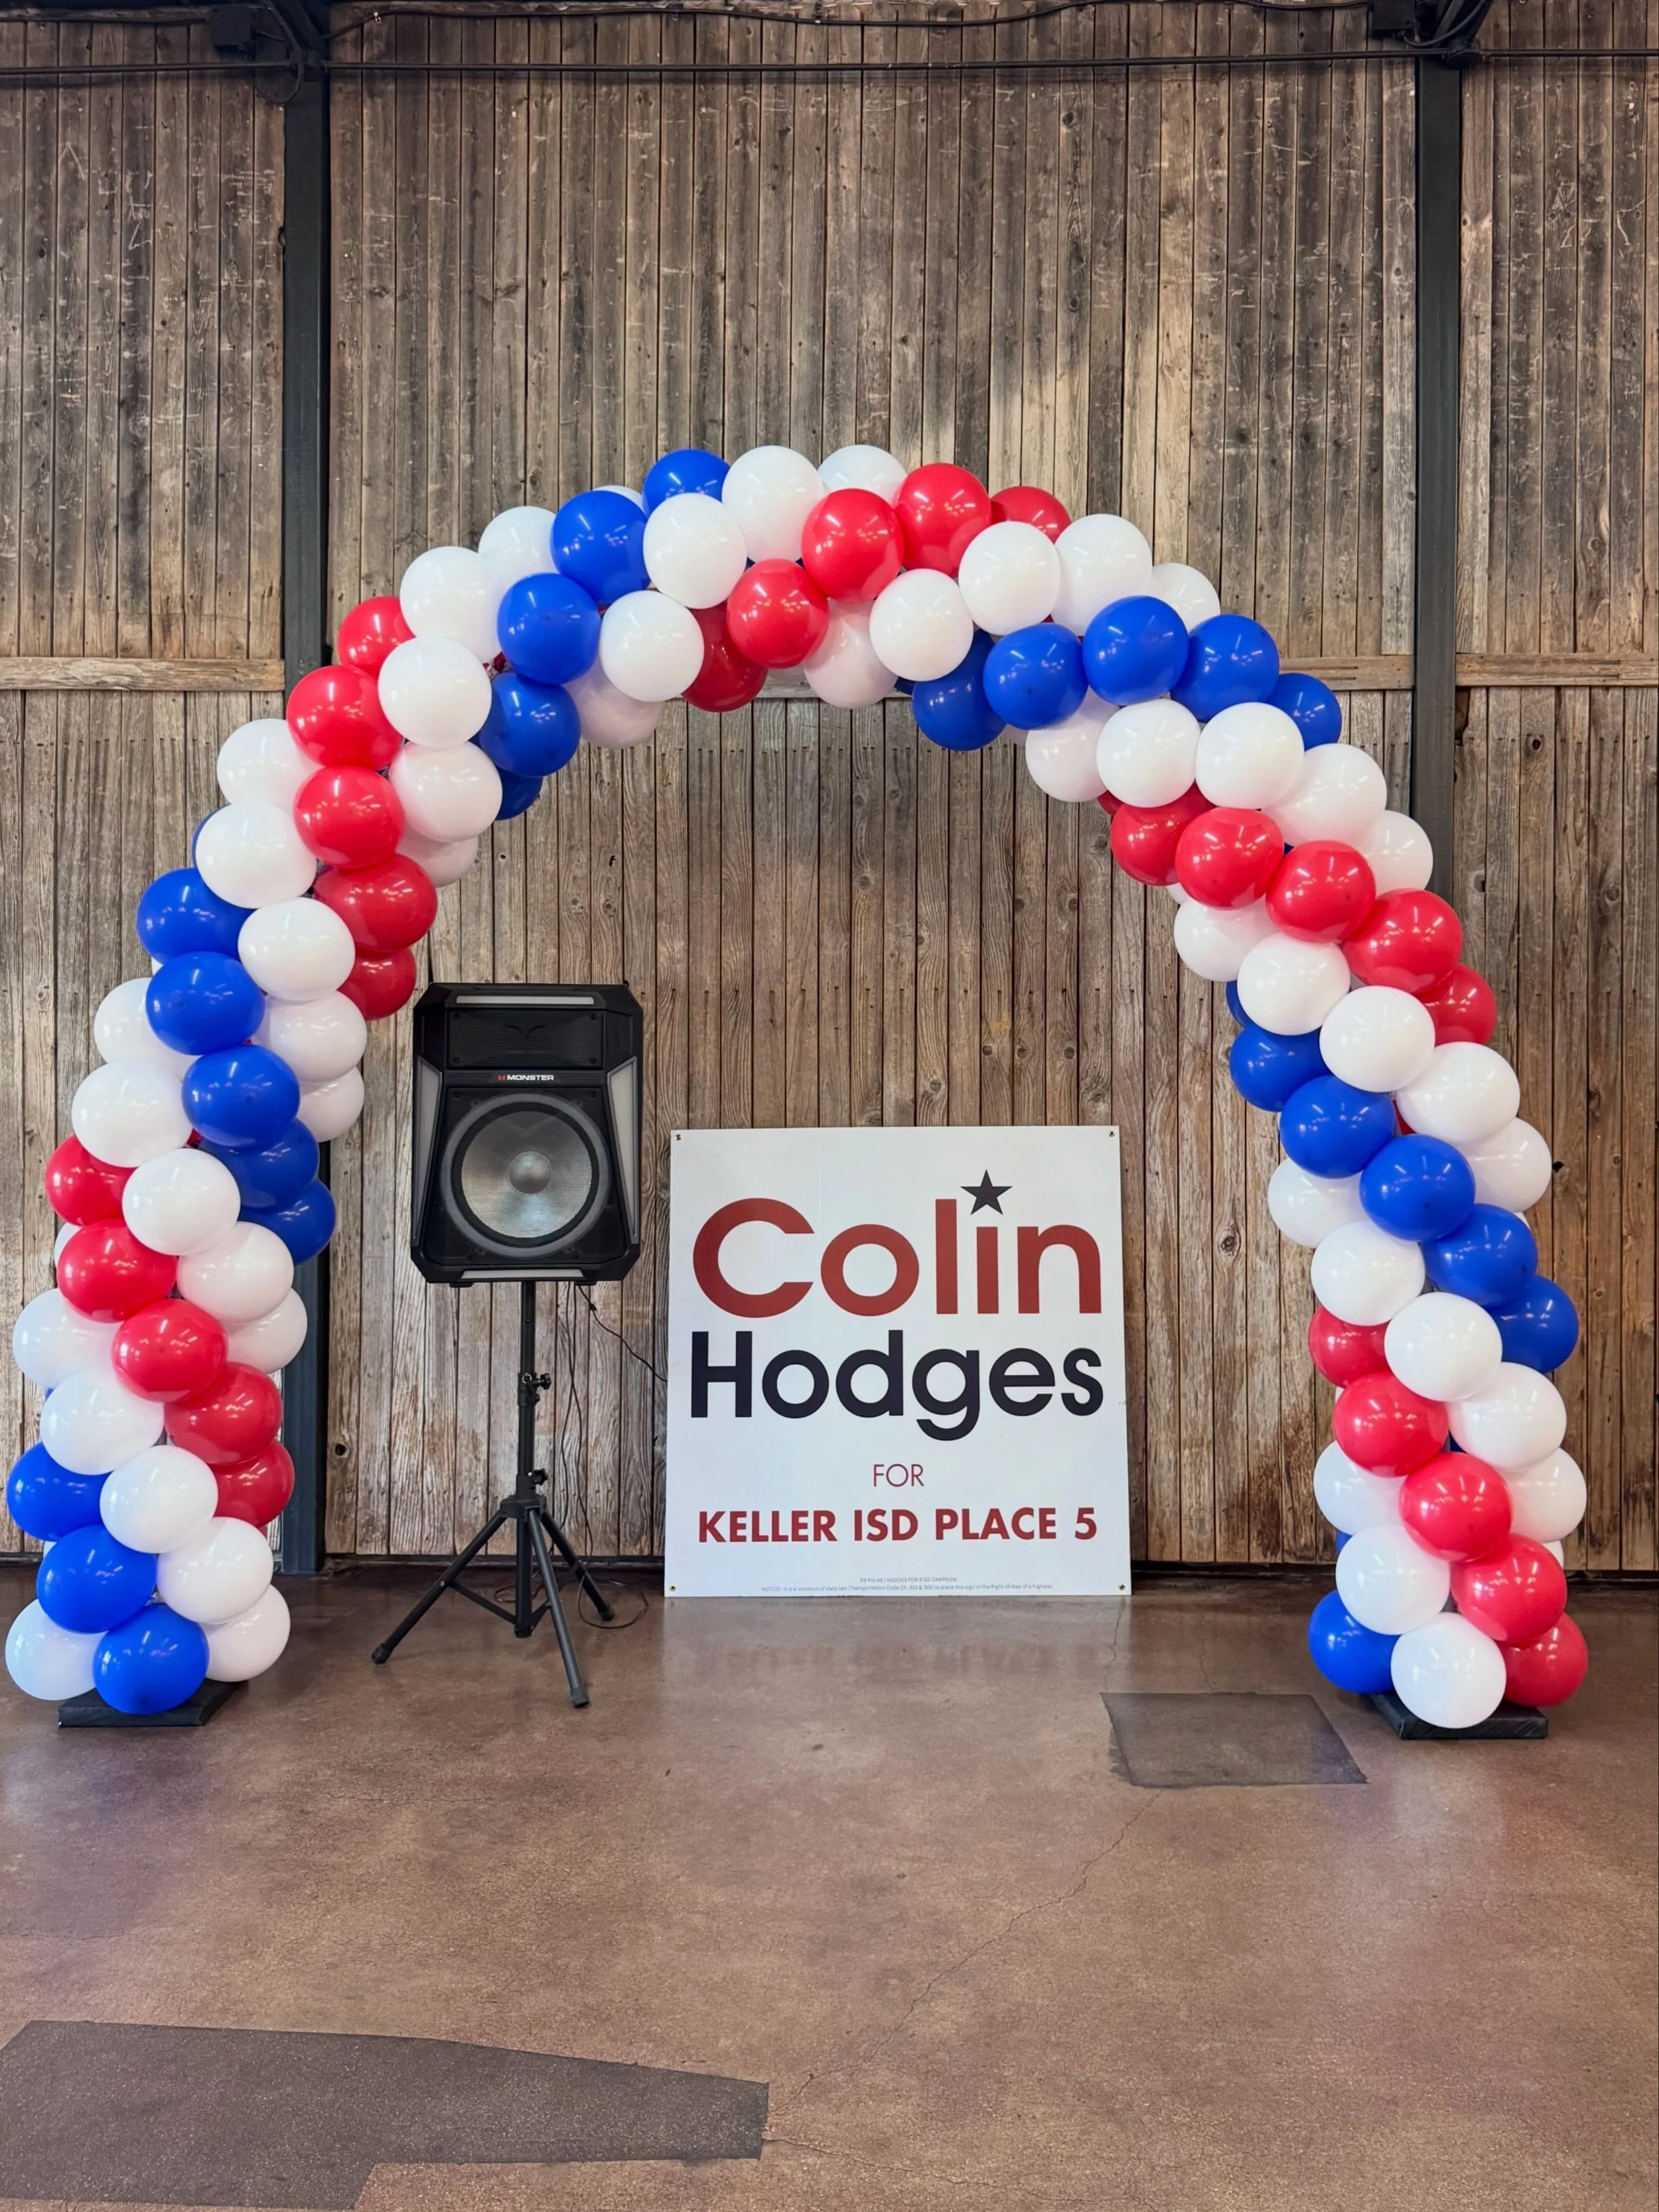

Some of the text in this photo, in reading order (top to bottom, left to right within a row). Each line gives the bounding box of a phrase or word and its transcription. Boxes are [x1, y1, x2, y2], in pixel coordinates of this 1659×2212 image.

[693, 1169, 1102, 1318] Colin
[691, 1330, 1103, 1441] Hodges
[874, 1464, 924, 1487] FOR
[699, 1507, 1096, 1542] KELLER ISD PLACE 5
